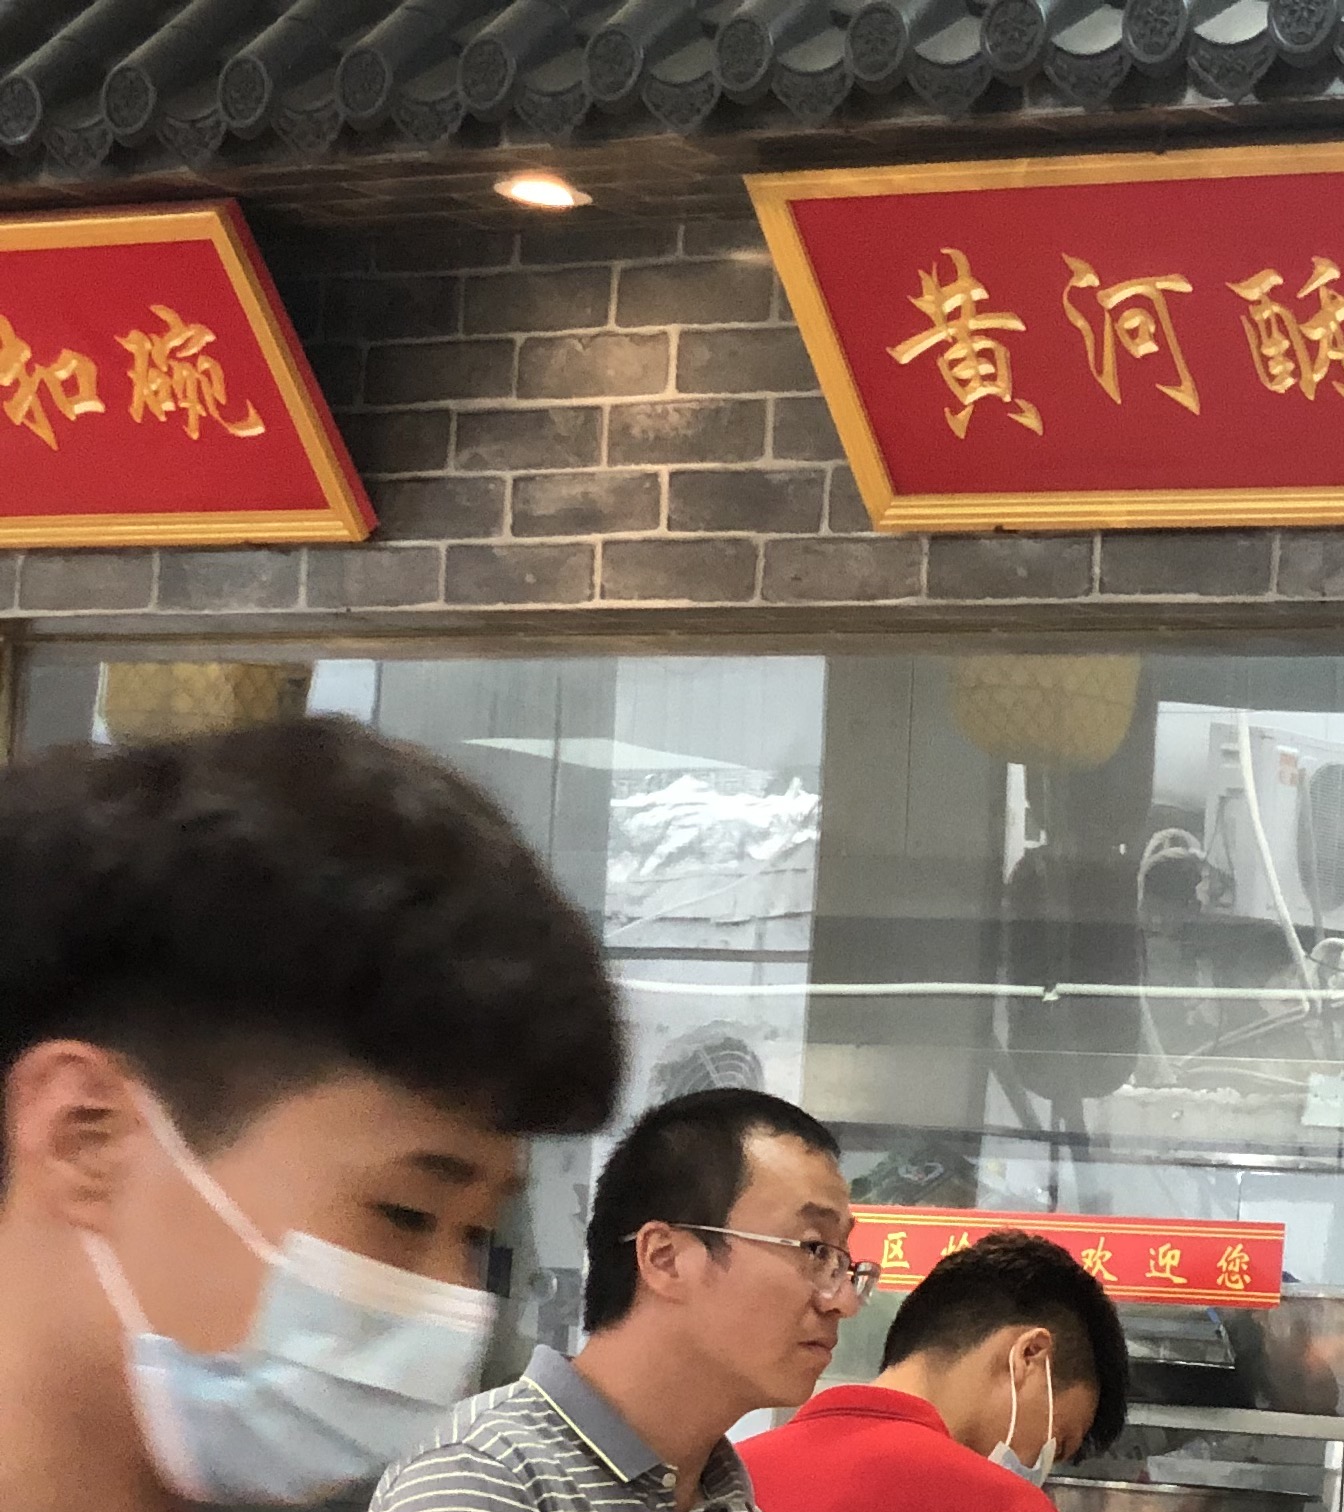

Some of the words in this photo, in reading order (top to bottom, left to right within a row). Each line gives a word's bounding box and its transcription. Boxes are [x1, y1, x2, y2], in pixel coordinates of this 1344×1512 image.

[0, 303, 266, 451] 扣碗
[881, 1230, 1252, 1291] 区欢迎您
